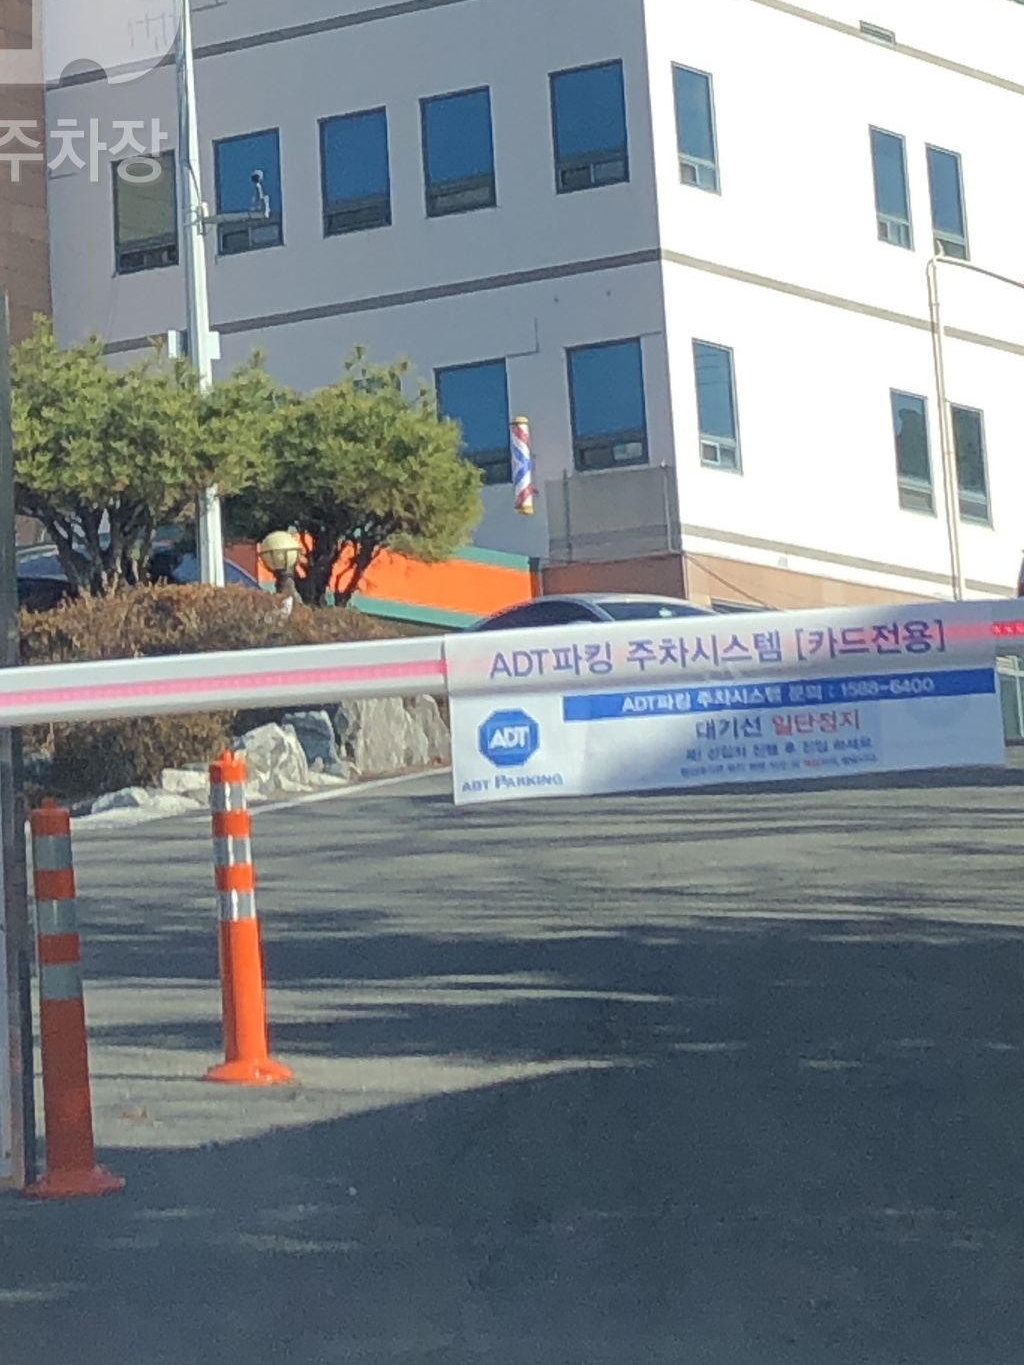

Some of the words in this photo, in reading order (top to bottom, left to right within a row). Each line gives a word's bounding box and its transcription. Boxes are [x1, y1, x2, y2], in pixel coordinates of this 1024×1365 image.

[490, 641, 614, 679] ADT파킹
[626, 629, 783, 672] 주차시스템
[794, 618, 946, 663] [카드전용]
[488, 725, 530, 750] ADT
[695, 715, 763, 740] 대기선
[771, 708, 861, 737] 일단정지
[462, 779, 489, 793] ADT
